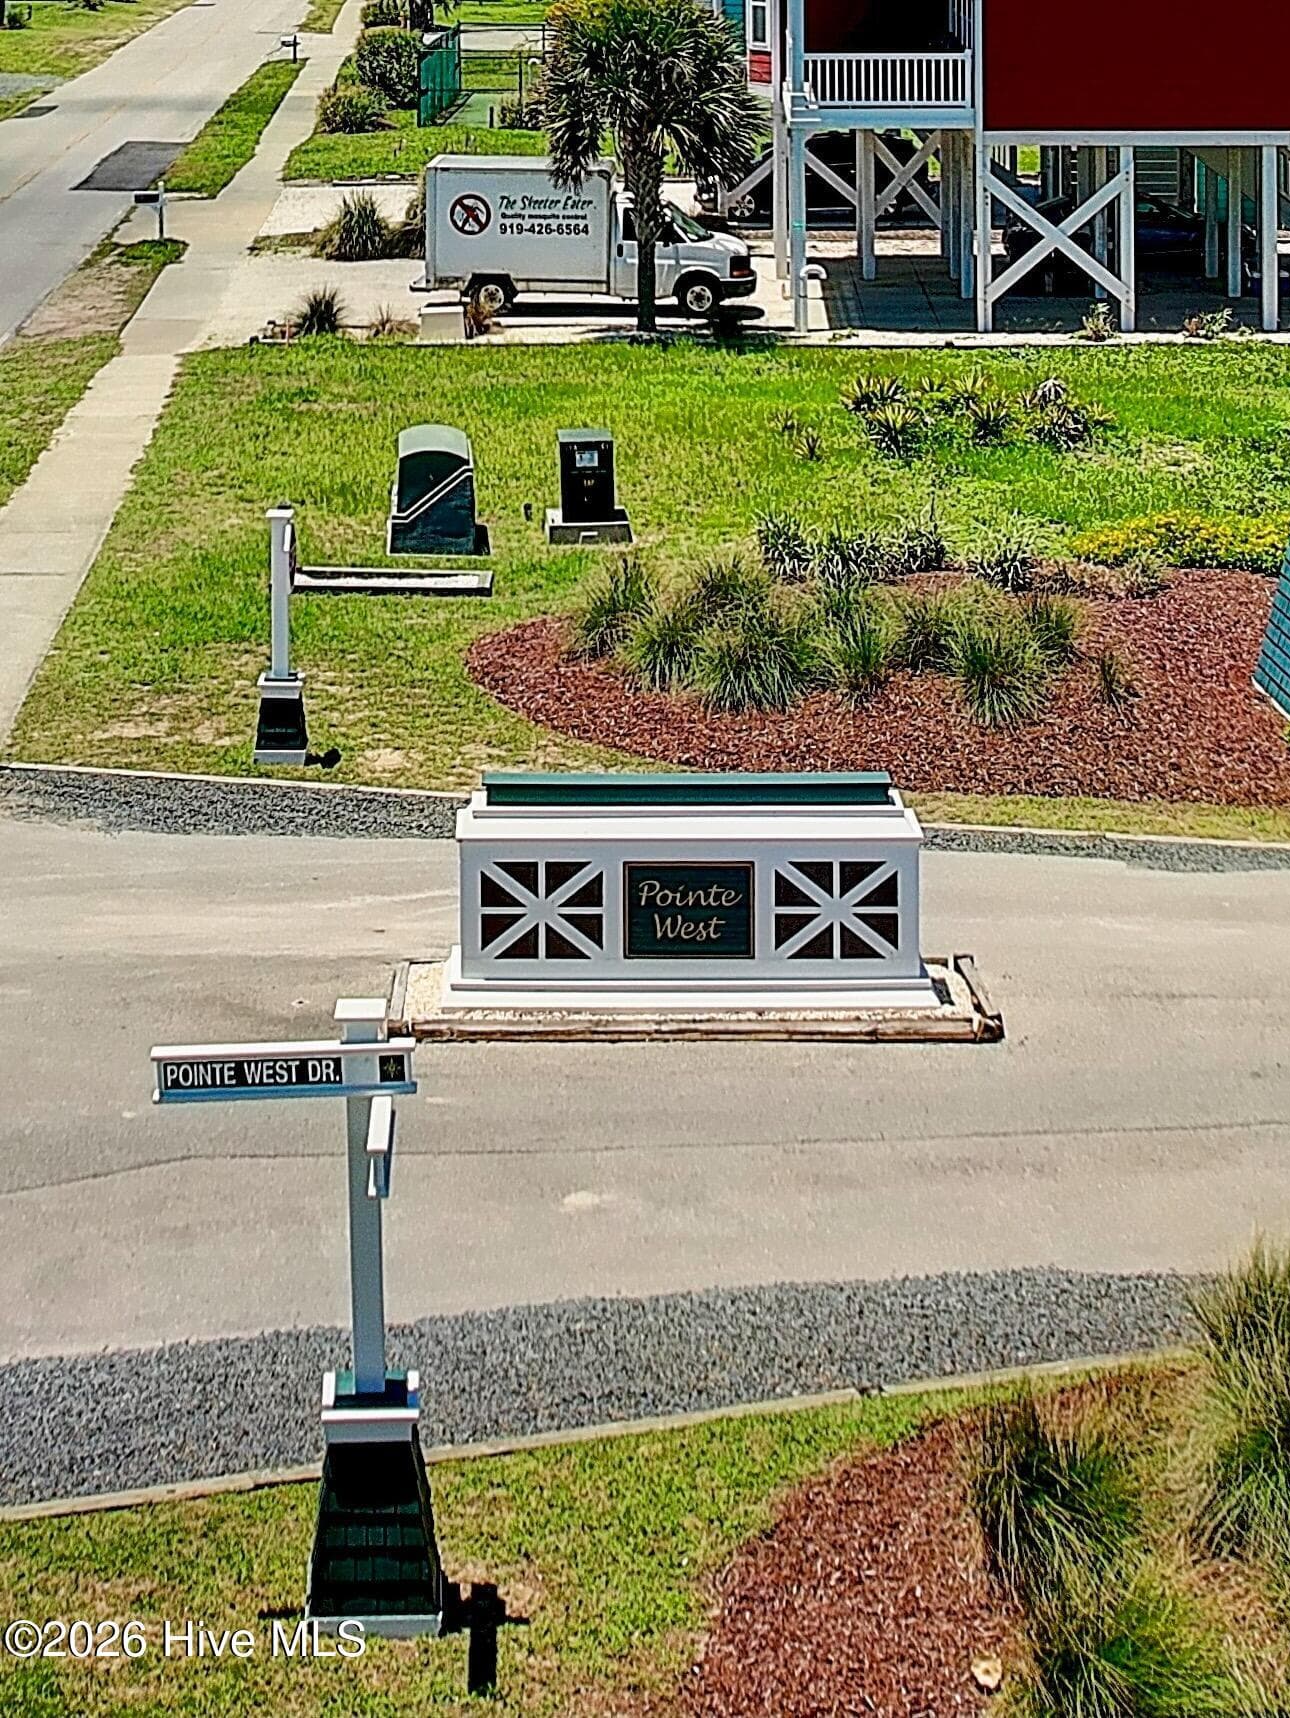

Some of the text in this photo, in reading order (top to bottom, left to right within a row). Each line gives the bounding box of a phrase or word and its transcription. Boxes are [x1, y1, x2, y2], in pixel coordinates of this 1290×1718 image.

[499, 195, 517, 210] The
[520, 195, 561, 210] Skeeter
[501, 212, 525, 221] Quality
[528, 213, 560, 221] mosquito
[499, 223, 589, 235] 919-426-6564
[638, 880, 743, 907] Pointe
[653, 913, 726, 942] West
[166, 1059, 340, 1087] POINTE WEST DR.
